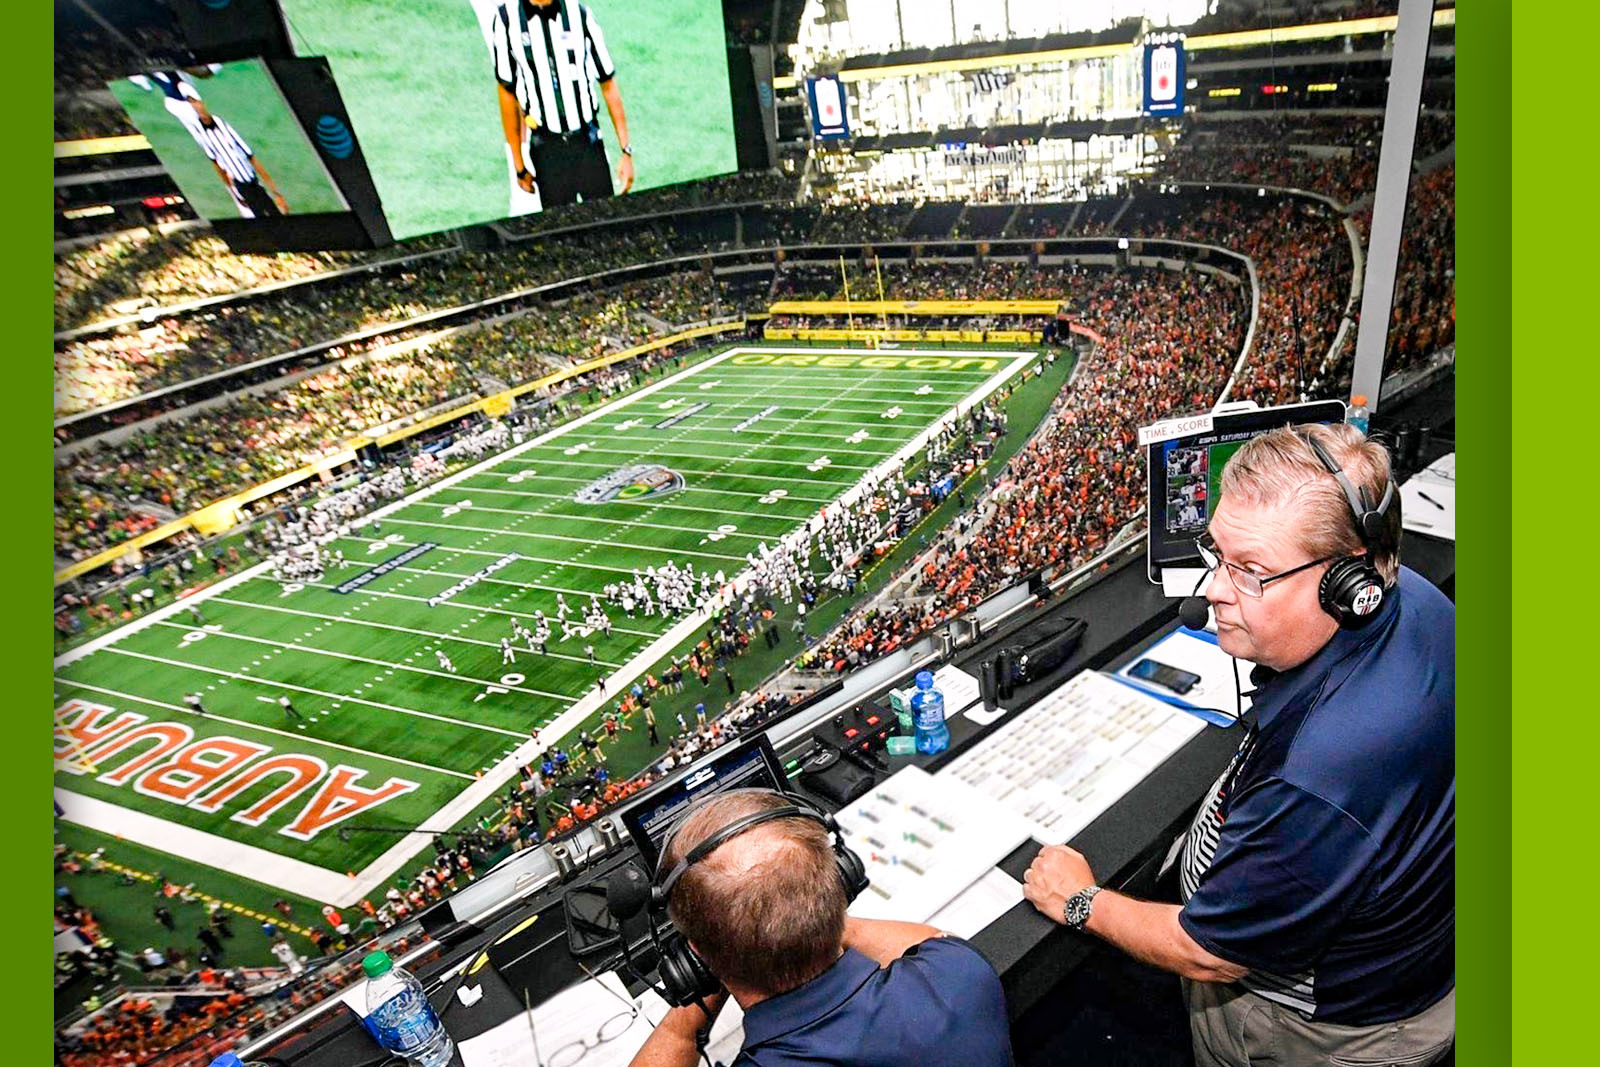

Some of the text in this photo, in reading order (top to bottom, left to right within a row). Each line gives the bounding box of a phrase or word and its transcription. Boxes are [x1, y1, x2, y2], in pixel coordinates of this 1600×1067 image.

[732, 354, 999, 369] OREGON
[1144, 427, 1168, 440] TIME
[1177, 419, 1210, 433] SCORE
